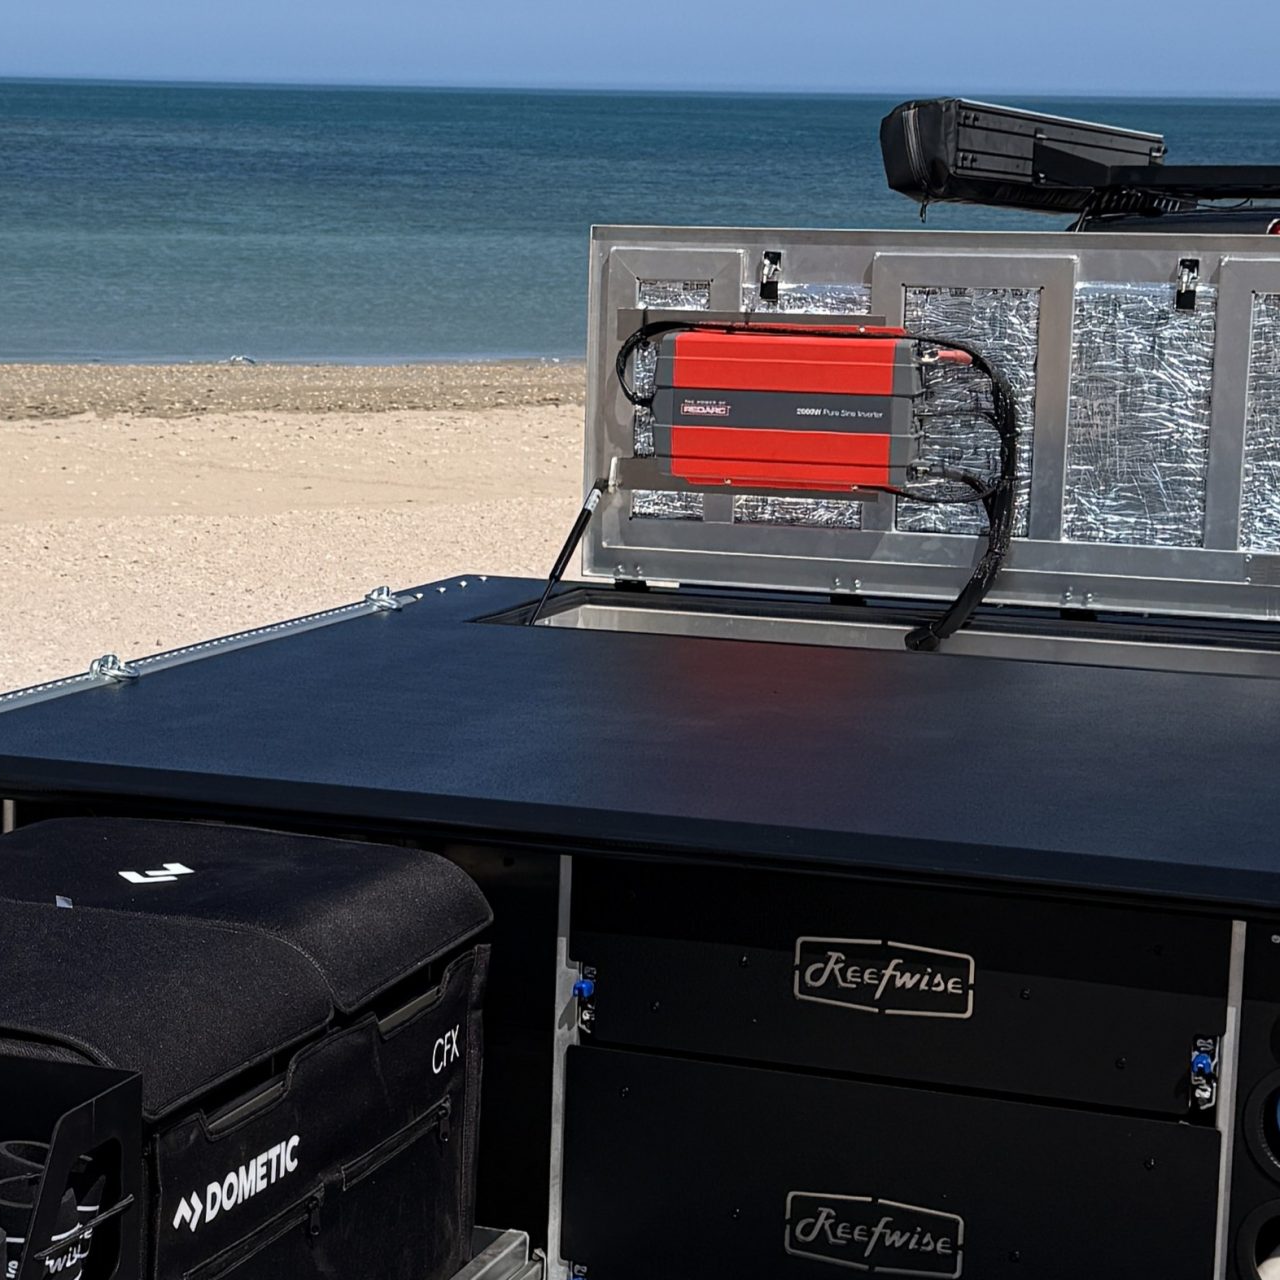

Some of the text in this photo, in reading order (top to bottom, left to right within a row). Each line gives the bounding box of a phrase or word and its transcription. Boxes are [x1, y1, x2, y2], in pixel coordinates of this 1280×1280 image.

[804, 951, 963, 1000] Reefwise
[432, 1023, 460, 1074] CFX
[205, 1134, 300, 1224] DOMETIC
[794, 1207, 953, 1257] Reefwise
